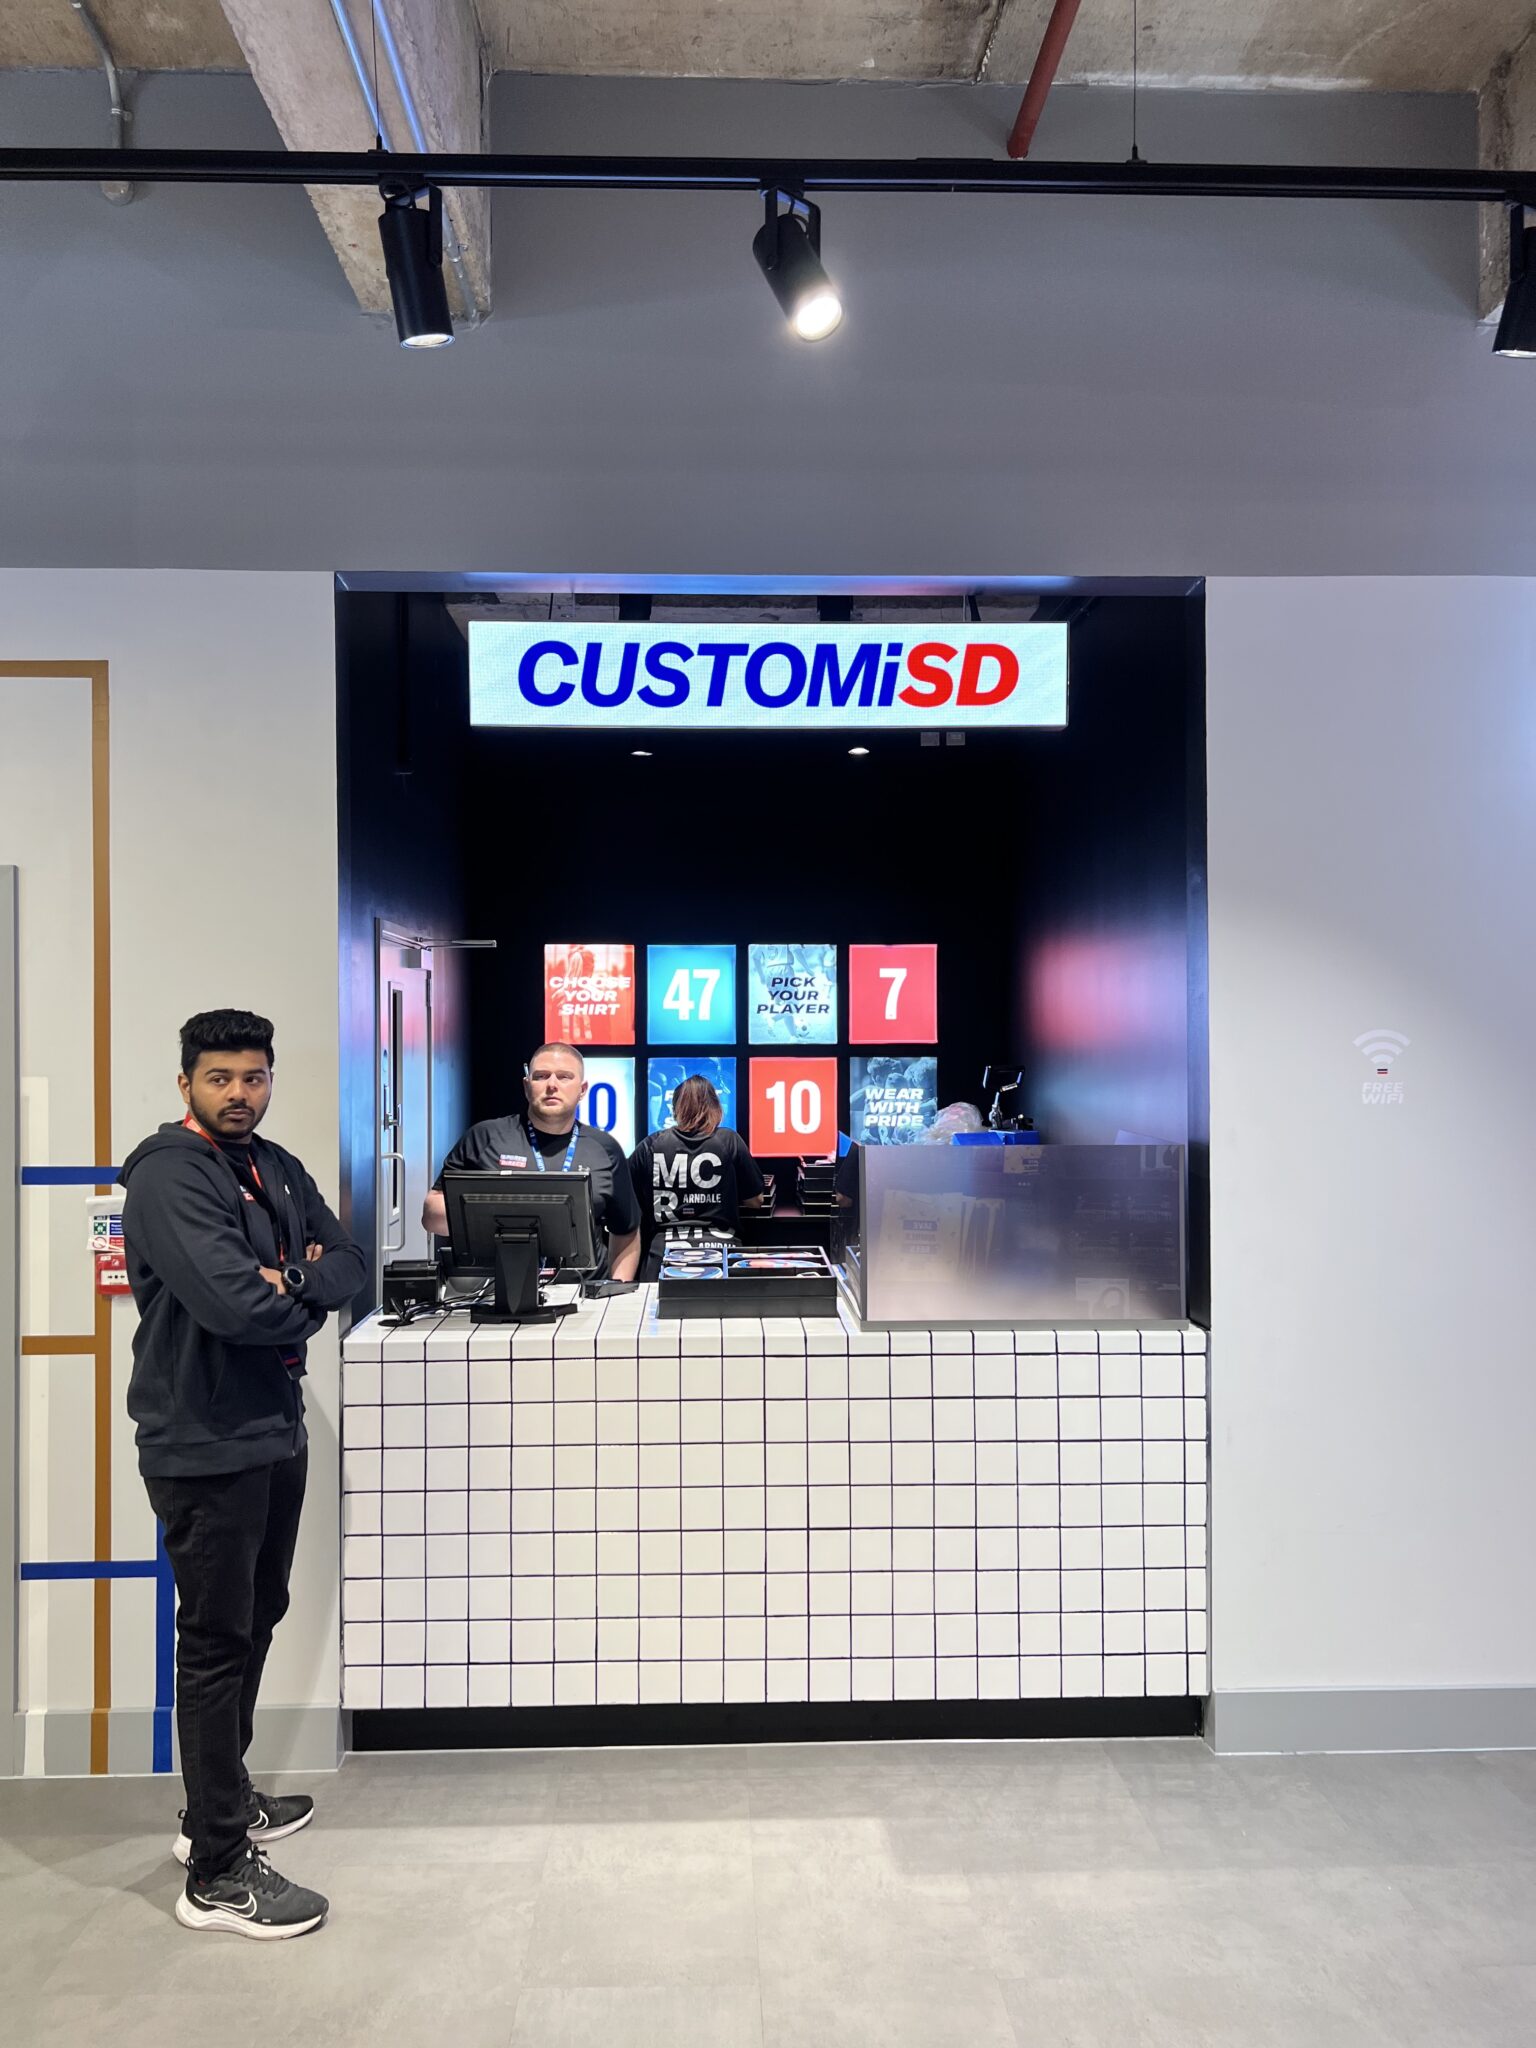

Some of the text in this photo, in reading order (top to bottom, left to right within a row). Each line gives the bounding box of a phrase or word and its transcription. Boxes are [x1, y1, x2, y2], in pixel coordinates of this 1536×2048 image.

[518, 640, 1020, 709] CUSTOMiSD
[550, 976, 631, 989] CHOOSE
[771, 976, 816, 988] PICK
[564, 990, 618, 1002] YOUR
[662, 968, 721, 1021] 47
[768, 990, 819, 1001] YOUR
[879, 967, 907, 1020] 7
[561, 1003, 620, 1016] SHIRT
[757, 1003, 830, 1014] PLAYER
[865, 1088, 924, 1100] WEAR
[1362, 1082, 1403, 1093] FREE
[1361, 1093, 1405, 1105] WIFI
[765, 1080, 821, 1134] 10
[869, 1101, 919, 1114] WITH
[865, 1115, 924, 1128] PRIDE
[653, 1152, 722, 1189] MC
[682, 1193, 722, 1204] ARNDALE
[653, 1189, 679, 1223] R
